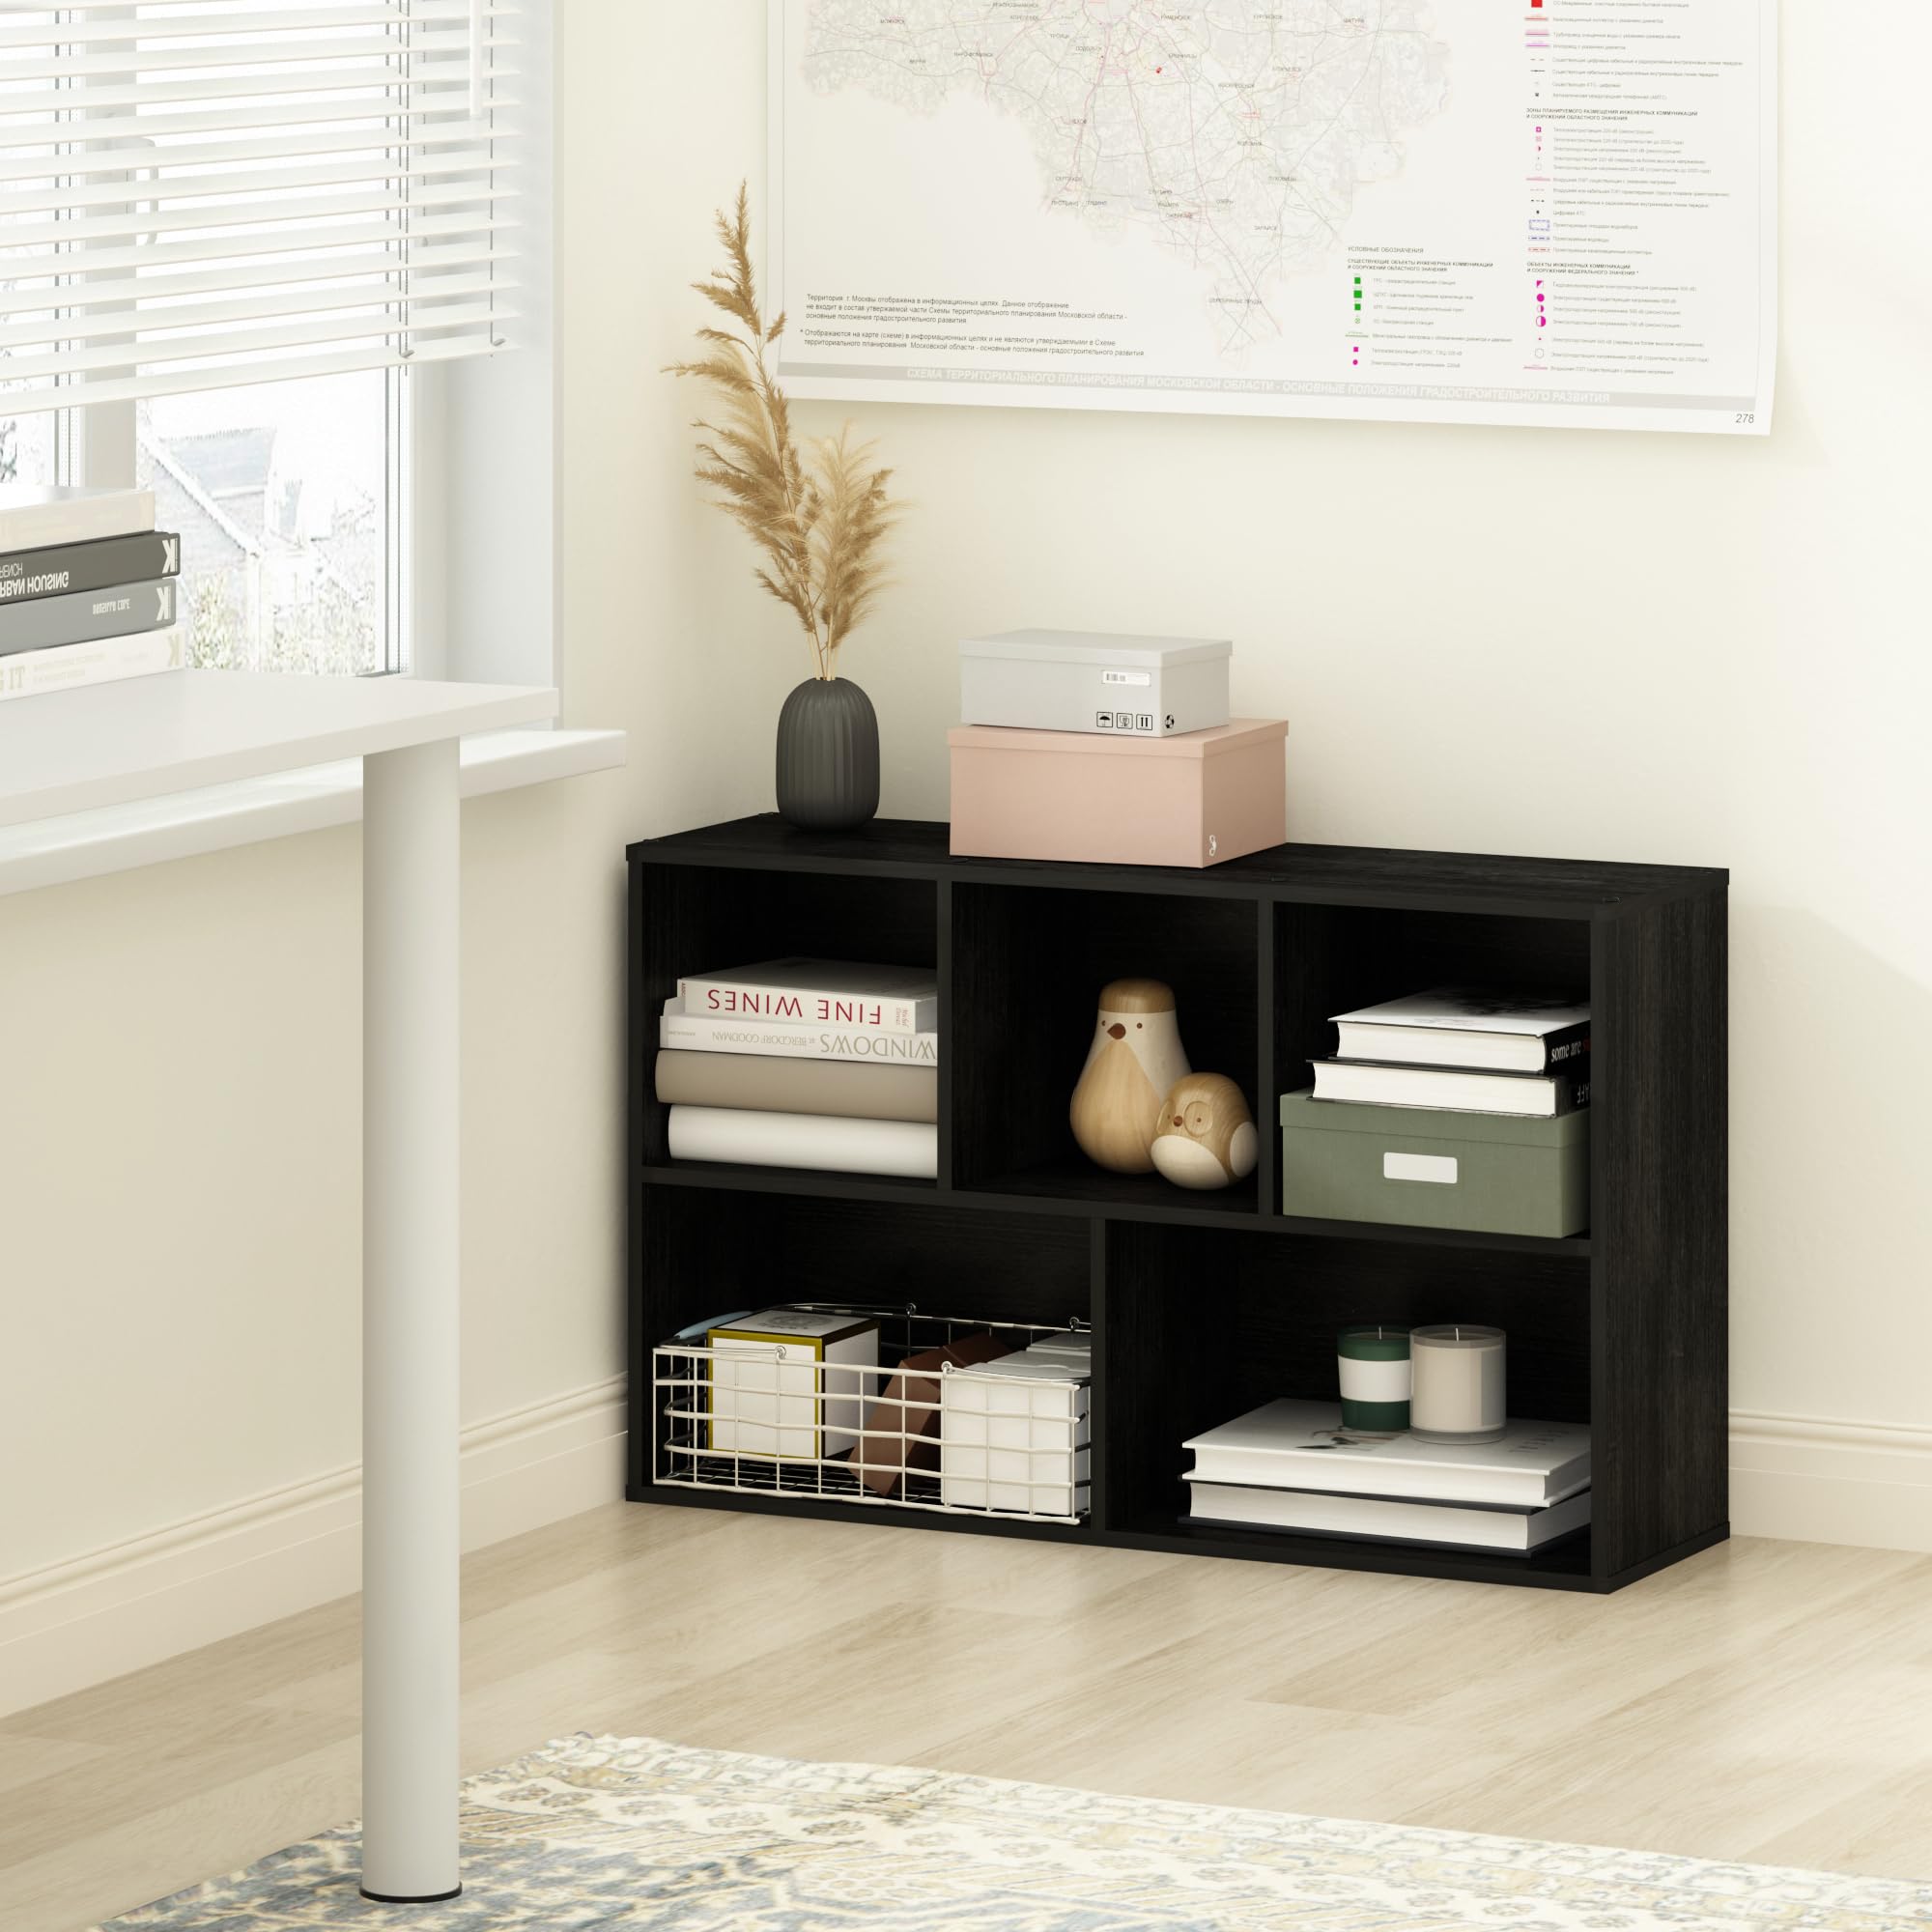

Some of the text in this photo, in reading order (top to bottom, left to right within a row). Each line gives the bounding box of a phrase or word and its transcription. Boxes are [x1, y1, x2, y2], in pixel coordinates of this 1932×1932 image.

[907, 369, 943, 380] СХЕМА
[946, 370, 1055, 384] ТЕРРИТОРИАЛЬНОГО
[1058, 374, 1144, 386] ПЛАНИРОВАНИЯ
[1348, 384, 1417, 397] ПОЛОЖЕНИЯ
[1420, 385, 1548, 402] ГРАДОСТРОИТЕЛЬНОГО
[1552, 390, 1610, 404] РАЗВИТИЯ
[1735, 413, 1755, 424] 278
[707, 988, 881, 1026] FINE WINES
[712, 1032, 759, 1045] GOODMAN
[760, 1033, 808, 1047] BERGDORF
[819, 1034, 936, 1060] WINDOWS
[1550, 1044, 1570, 1064] some
[1570, 1040, 1581, 1057] are
